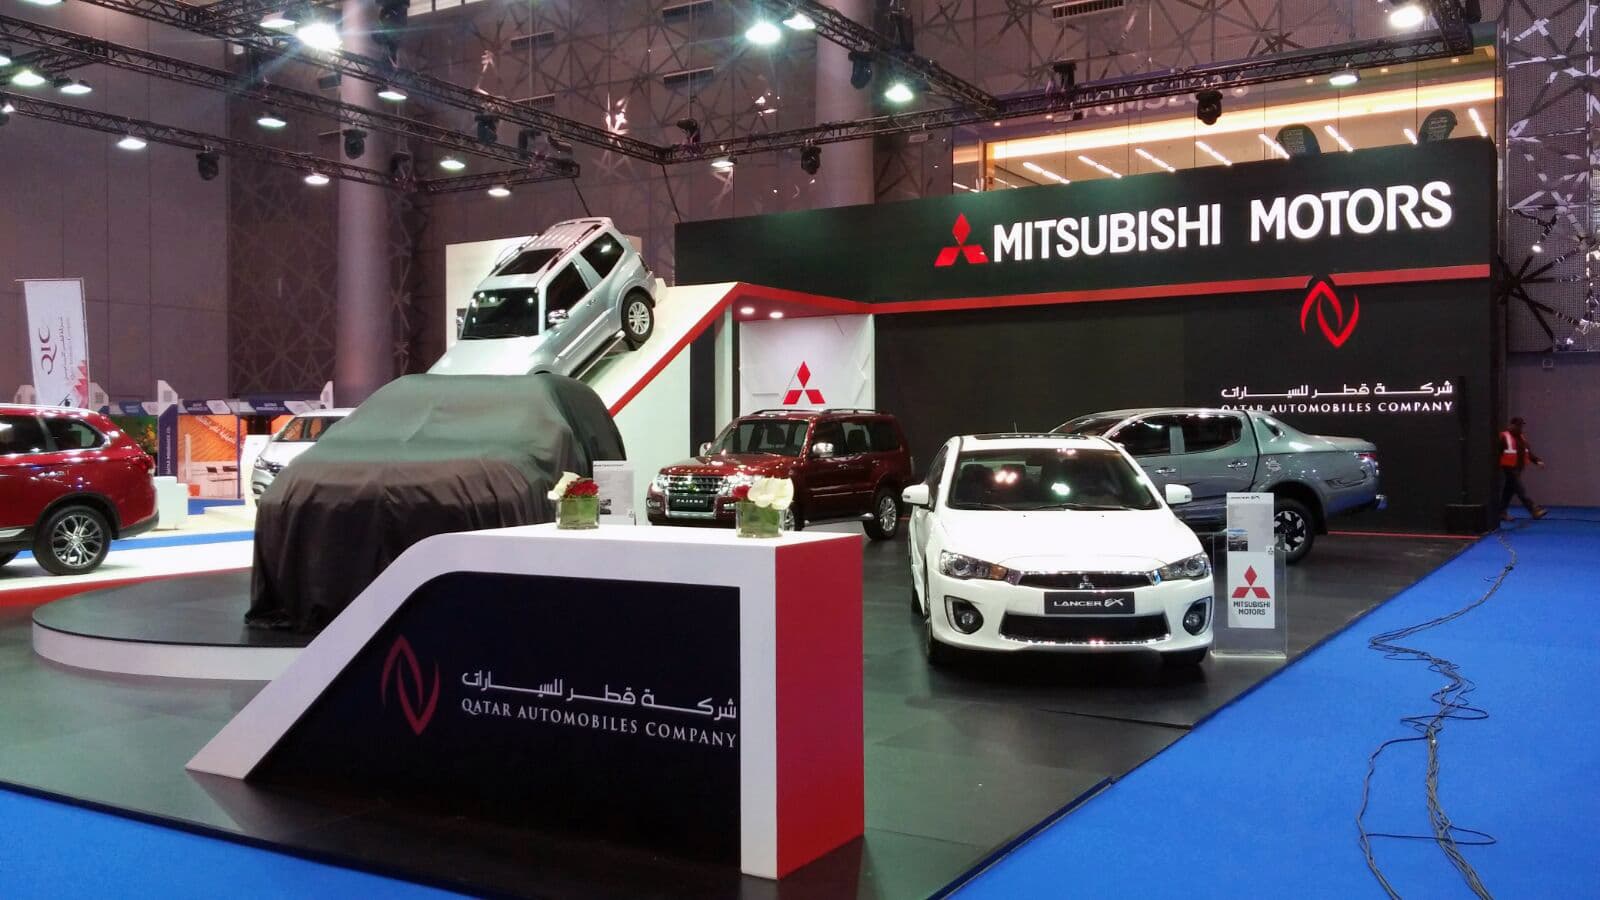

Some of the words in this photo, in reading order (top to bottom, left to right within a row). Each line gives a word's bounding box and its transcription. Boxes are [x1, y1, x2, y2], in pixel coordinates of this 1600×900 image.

[993, 202, 1221, 263] MITSUBISHI
[1250, 180, 1453, 242] MOTORS
[38, 325, 57, 375] QIC
[1221, 384, 1309, 400] للسيارات
[1311, 383, 1369, 399] قطر
[1374, 380, 1453, 397] شركة
[1270, 403, 1372, 413] AUTOMOBILES
[1378, 401, 1453, 412] COMPANY
[1104, 598, 1125, 607] EX
[1233, 600, 1271, 608] MITSUBISHI
[1238, 608, 1266, 616] MOTORS
[462, 670, 564, 698] للسيارات
[566, 684, 636, 706] قطر
[641, 689, 736, 721] شركة
[462, 697, 512, 717] QATAR
[518, 705, 638, 734] AUTOMOBILES
[646, 722, 736, 749] COMPANY
